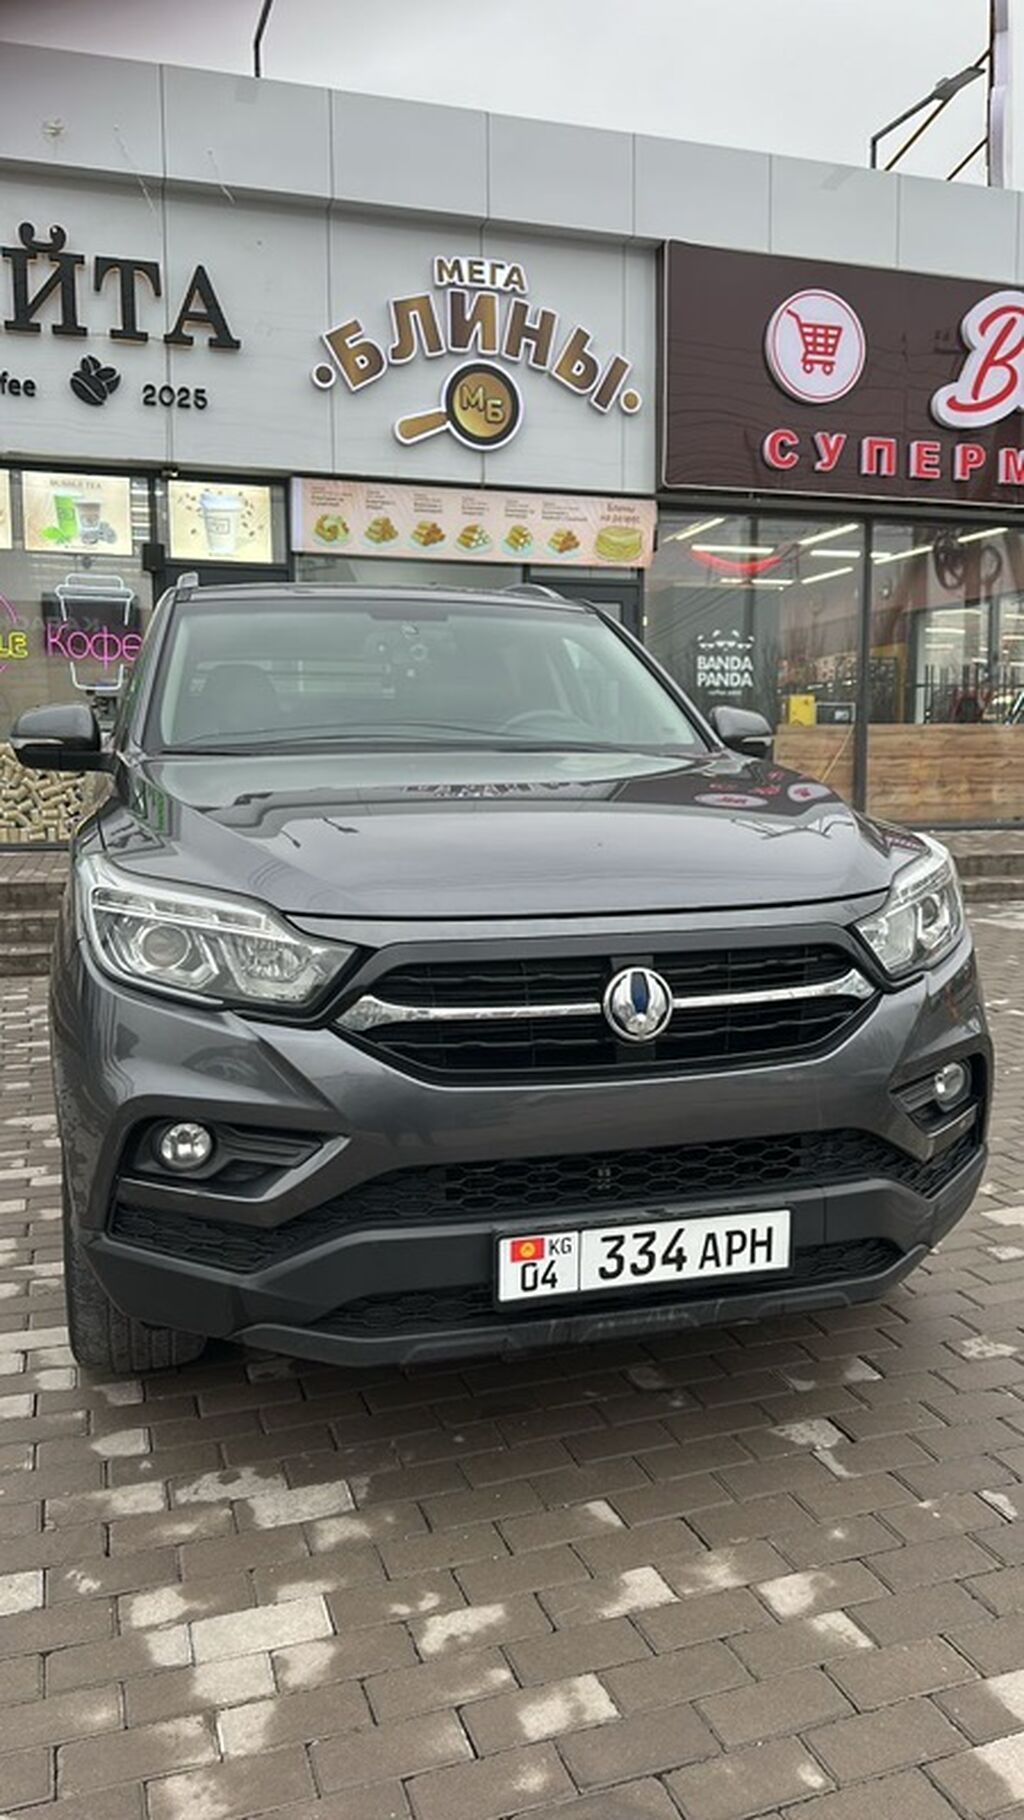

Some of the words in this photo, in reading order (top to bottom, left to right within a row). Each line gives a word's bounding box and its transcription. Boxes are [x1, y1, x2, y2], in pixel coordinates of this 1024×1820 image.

[2, 222, 241, 350] ЙТА
[435, 256, 528, 293] МЕГА
[322, 289, 630, 414] БЛИНЫ
[142, 384, 208, 410] 2025
[46, 622, 142, 672] Кофе
[697, 655, 753, 670] BANDA
[697, 671, 753, 687] PANDA
[548, 1237, 572, 1256] KG
[598, 1227, 688, 1280] 334
[698, 1226, 773, 1270] APH
[520, 1260, 558, 1292] 04
